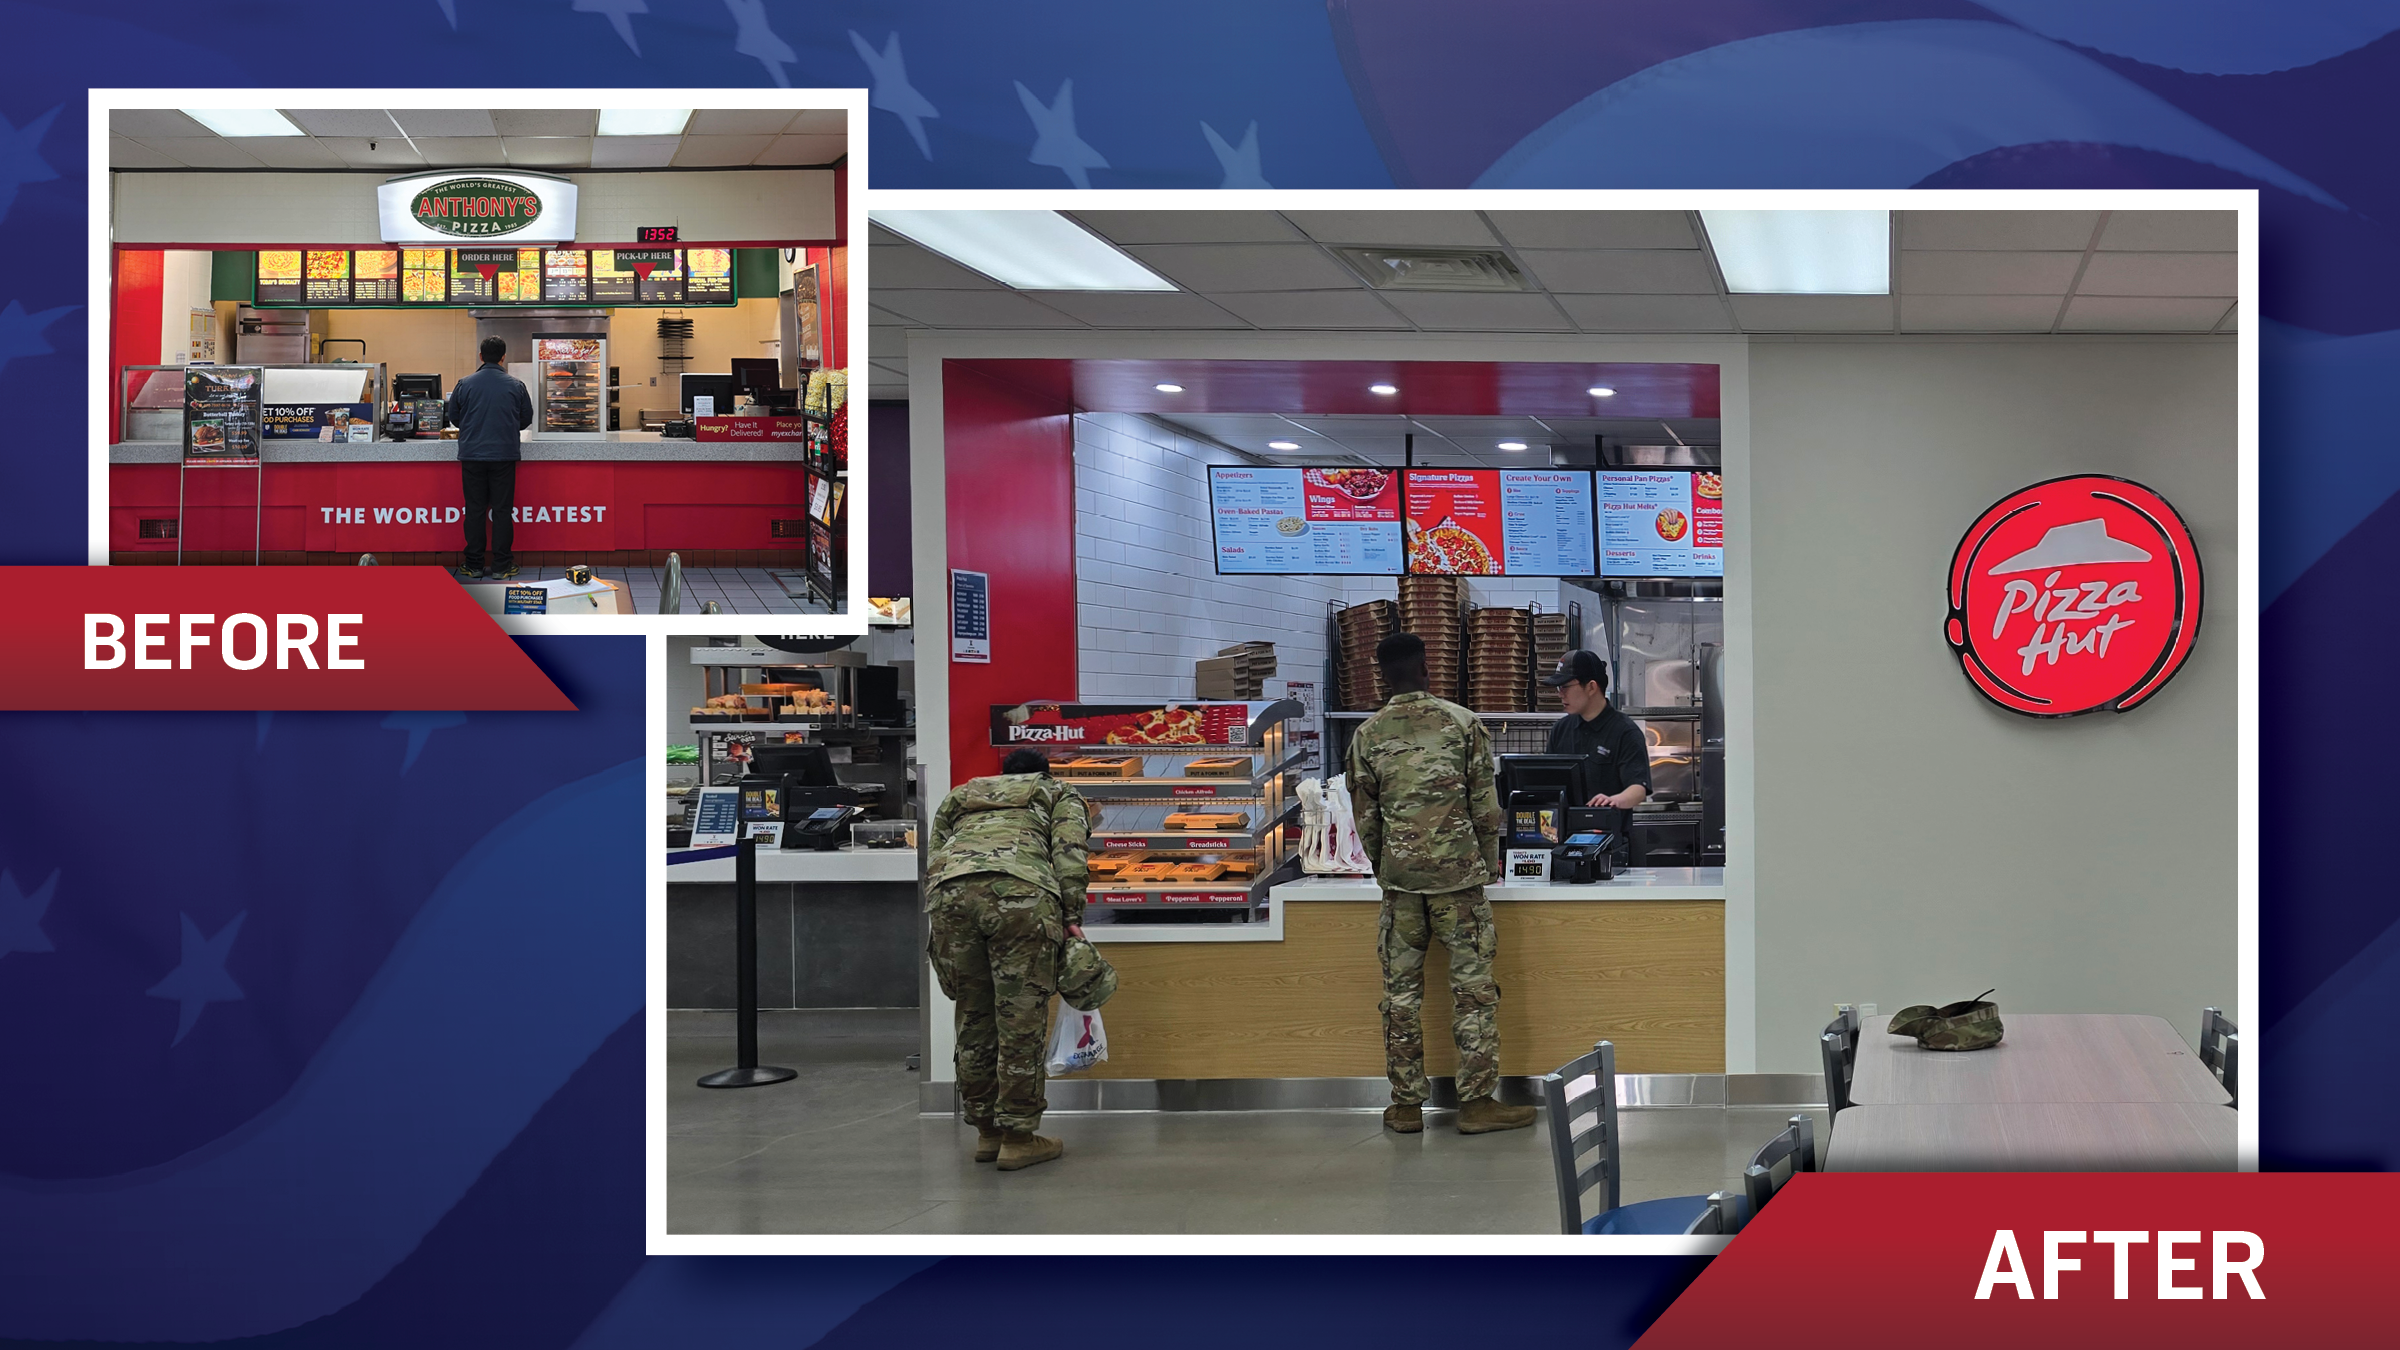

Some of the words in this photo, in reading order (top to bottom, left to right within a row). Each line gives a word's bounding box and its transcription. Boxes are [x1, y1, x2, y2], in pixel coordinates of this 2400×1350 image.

[435, 186, 448, 194] THE
[450, 182, 481, 190] WORLD'S
[482, 182, 517, 193] GREATEST
[417, 196, 537, 218] ANTHONY'S
[452, 222, 501, 232] PIZZA
[644, 228, 675, 240] 1352
[262, 408, 274, 416] ET
[274, 408, 295, 416] 10%
[296, 408, 315, 416] OFF
[700, 424, 728, 433] Hungry?
[771, 430, 802, 438] myexchan
[1409, 473, 1448, 482] Signature
[1449, 473, 1474, 482] Pizzas
[1309, 495, 1336, 504] Wings
[320, 507, 366, 524] THE
[374, 507, 466, 524] WORLD'
[1992, 570, 2142, 640] Pizza
[2017, 613, 2136, 676] Hut
[1009, 725, 1053, 741] Pizza
[1054, 726, 1084, 741] Hut
[1518, 866, 1541, 874] 1490
